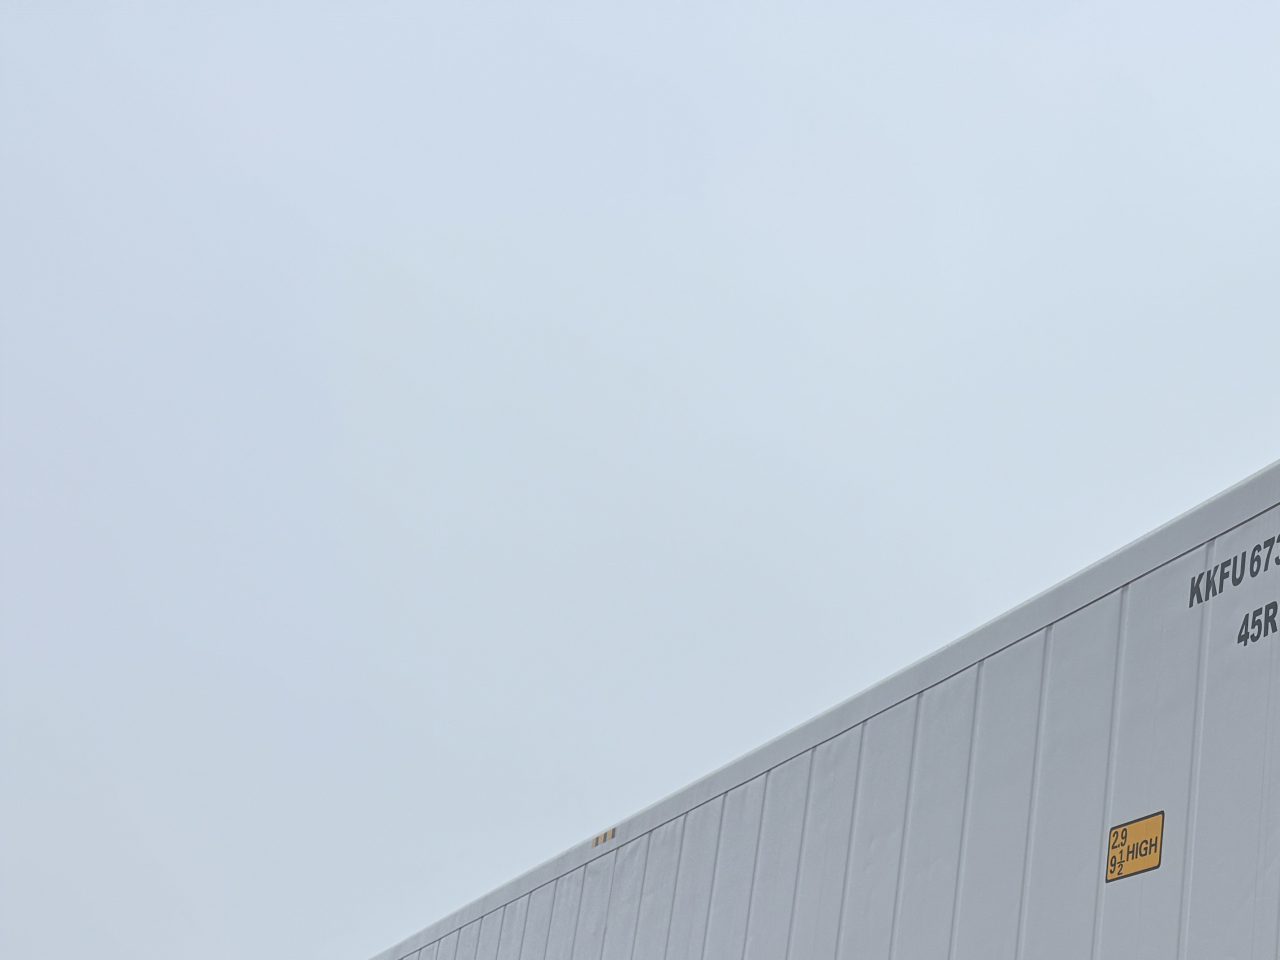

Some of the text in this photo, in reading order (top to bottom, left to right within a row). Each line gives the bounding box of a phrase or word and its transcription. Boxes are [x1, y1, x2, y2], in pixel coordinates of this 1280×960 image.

[1188, 550, 1248, 609] KKFU
[1111, 827, 1128, 850] 2.9
[1126, 835, 1158, 862] HIGH
